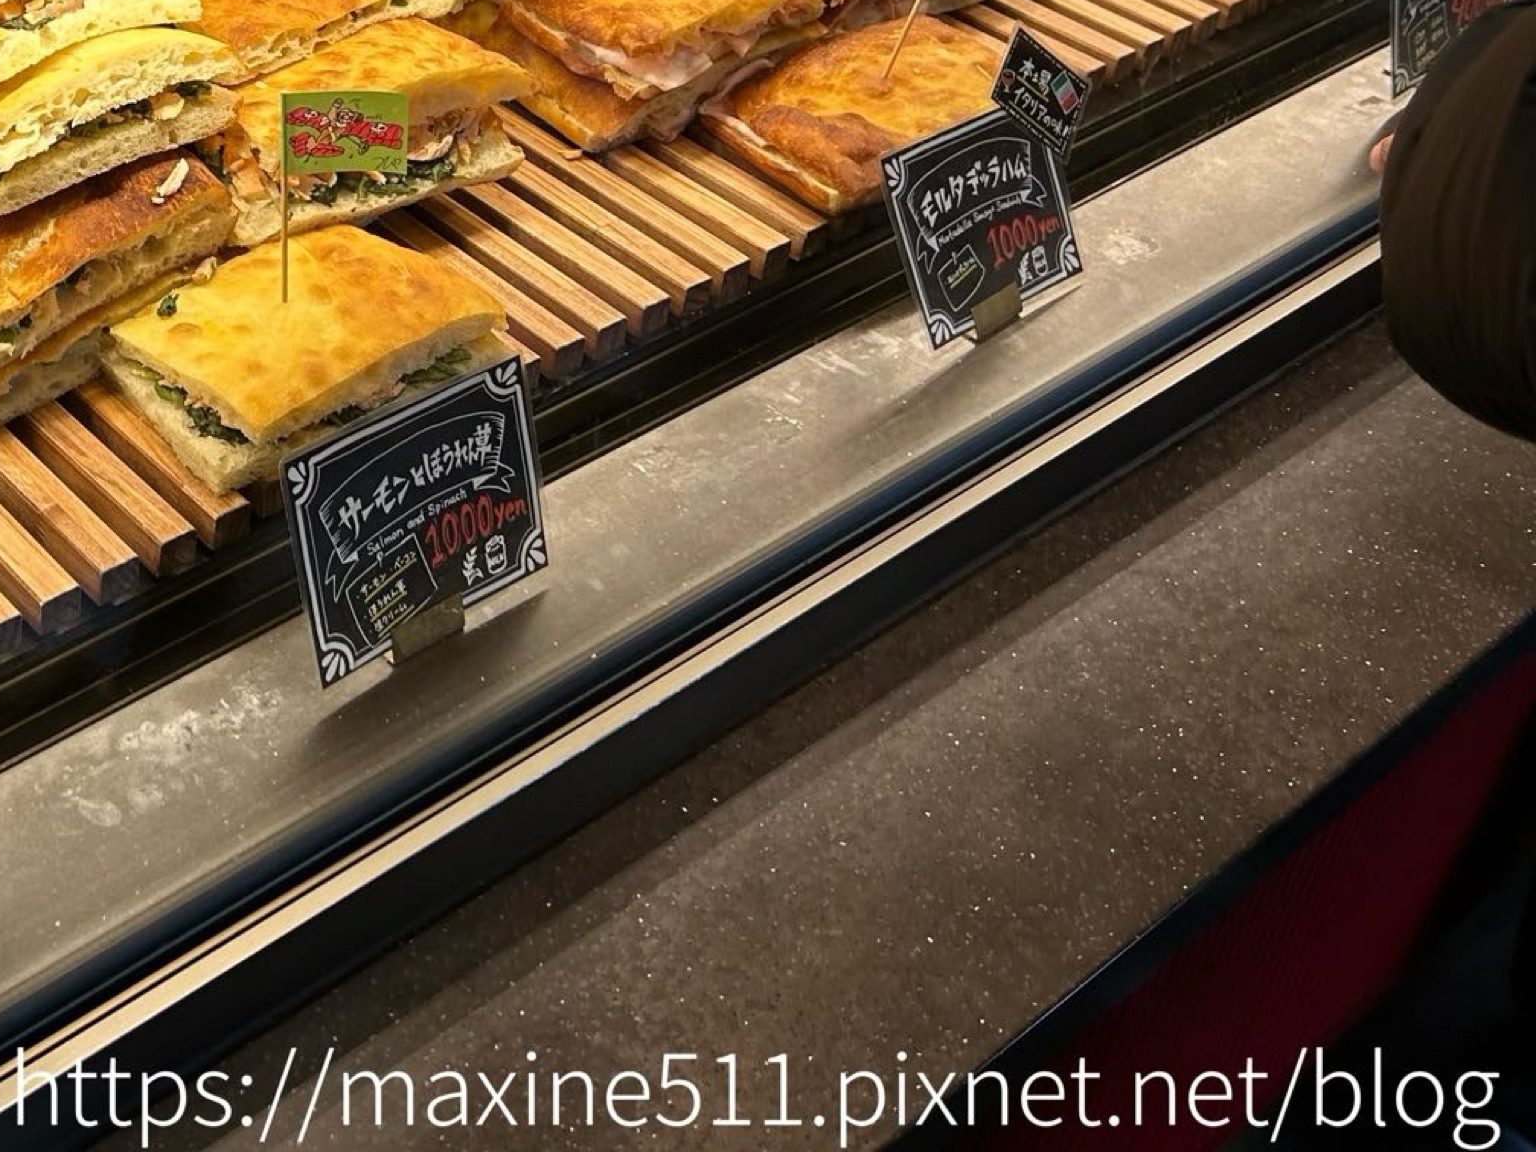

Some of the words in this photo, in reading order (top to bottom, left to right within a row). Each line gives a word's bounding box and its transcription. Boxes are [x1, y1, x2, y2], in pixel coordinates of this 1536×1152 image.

[920, 152, 1027, 228] モルタデッラハム
[338, 421, 492, 540] サーモンとほうれん草
[366, 528, 405, 557] Salmon
[407, 513, 426, 530] and
[427, 490, 468, 517] Spinach
